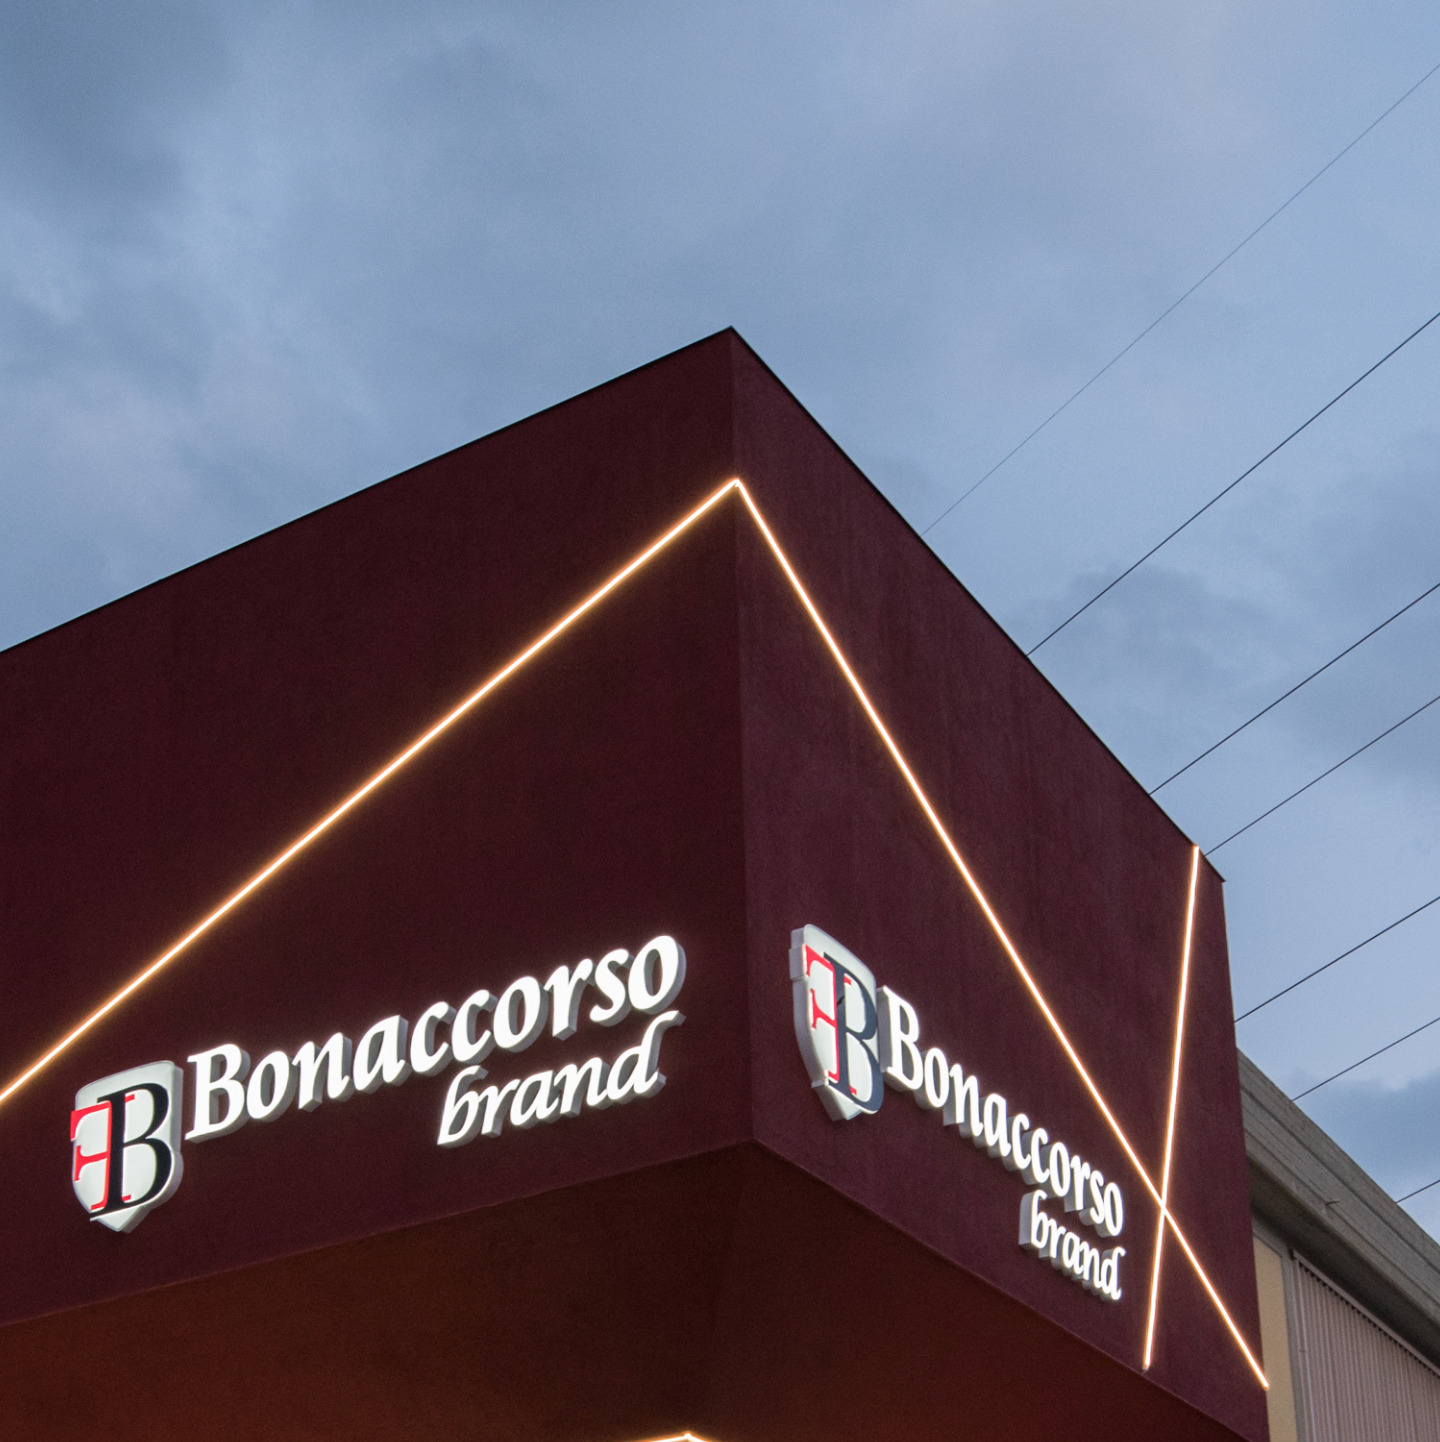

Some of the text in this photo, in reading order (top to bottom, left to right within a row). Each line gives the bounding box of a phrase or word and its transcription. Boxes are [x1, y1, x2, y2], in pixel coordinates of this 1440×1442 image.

[184, 935, 685, 1142] Bonaccorso
[436, 1009, 681, 1147] brand
[880, 985, 1124, 1237] Bonaccorso
[1026, 1189, 1126, 1300] brand
